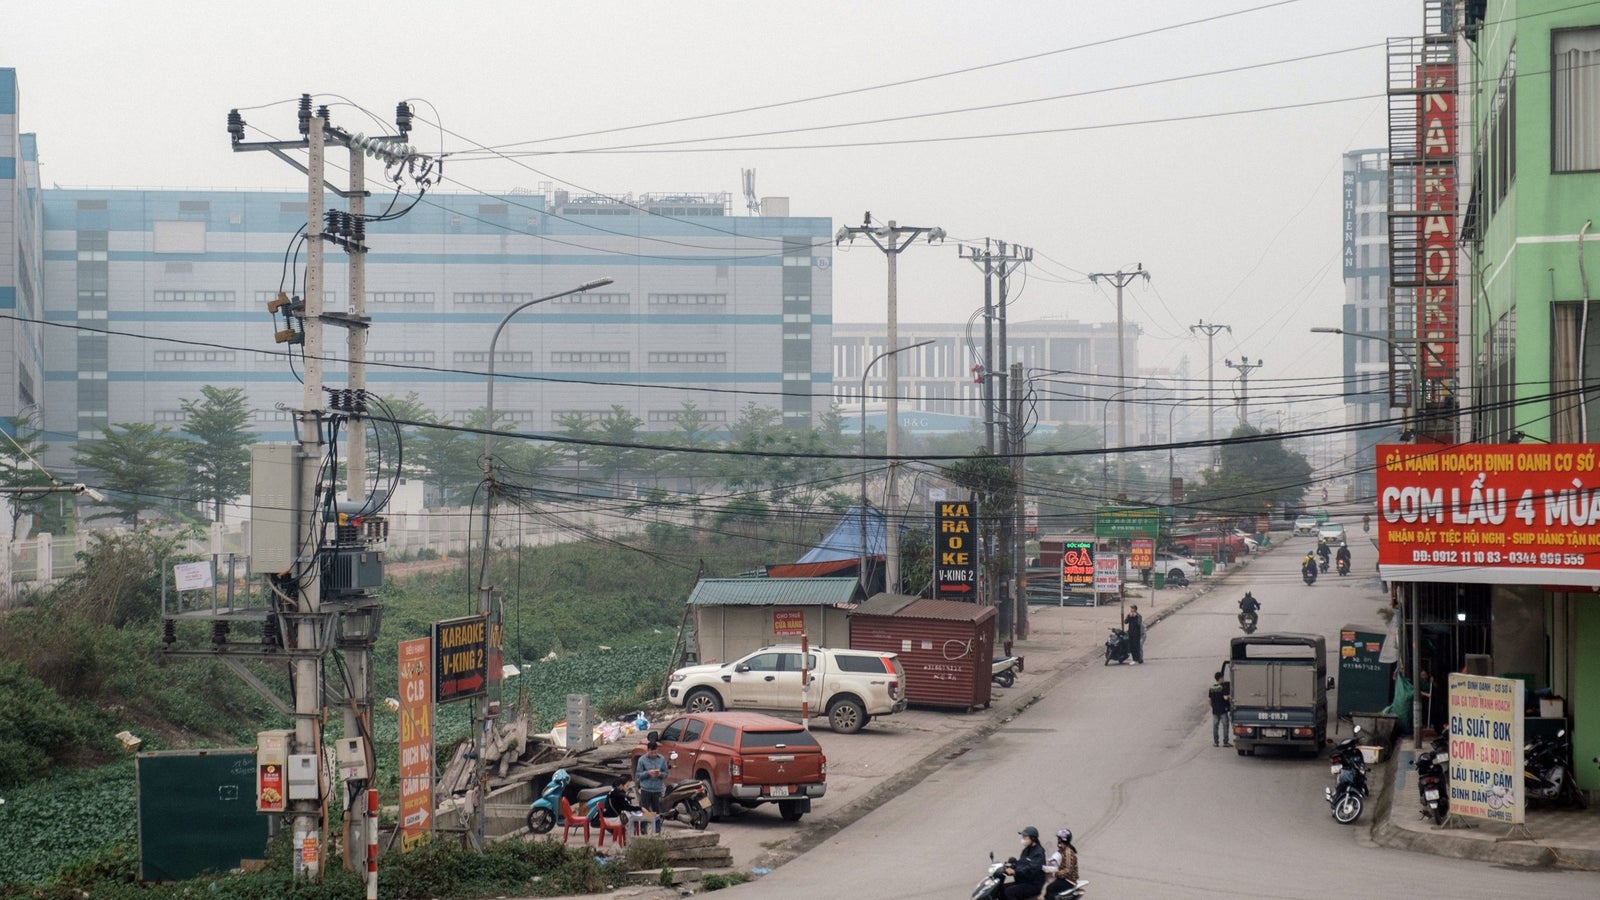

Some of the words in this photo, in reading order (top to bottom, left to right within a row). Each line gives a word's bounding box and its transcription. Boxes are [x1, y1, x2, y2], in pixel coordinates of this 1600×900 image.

[1424, 76, 1450, 368] KARAOKE
[1386, 449, 1403, 471] GÀ
[1405, 454, 1439, 476] MẠNH
[1442, 454, 1482, 476] HOẠCH
[1485, 454, 1514, 475] ĐỊNH
[1517, 454, 1551, 471] OANH
[1555, 454, 1573, 471] CƠ
[1576, 448, 1595, 472] SỞ
[1383, 486, 1443, 524] CƠM
[1452, 473, 1506, 526] LẨU
[1515, 489, 1536, 526] 4
[942, 504, 969, 517] KA
[942, 521, 969, 533] RA
[949, 537, 962, 549] O
[1388, 528, 1415, 545] NHẬN
[1417, 528, 1437, 546] ĐẶT
[1440, 529, 1461, 546] TIỆC
[1463, 529, 1479, 547] HỘI
[1481, 532, 1505, 548] NGHỊ
[1513, 533, 1535, 544] SHIP
[1537, 529, 1564, 545] HÀNG
[1566, 530, 1586, 548] TẬN
[942, 552, 969, 565] KE
[1064, 547, 1093, 566] GÀ
[1432, 551, 1457, 563] 0912
[1461, 551, 1471, 563] 11
[1473, 551, 1485, 563] 10
[1487, 551, 1501, 563] 83
[1509, 552, 1537, 564] 0344
[939, 569, 967, 581] V-KING
[969, 570, 974, 581] 2
[442, 622, 484, 649] KARAOKE
[443, 650, 475, 675] V-KING
[477, 648, 484, 668] 2
[407, 679, 424, 701] CLB
[402, 704, 430, 743] BI-A
[1451, 713, 1463, 735] GÀ
[1466, 712, 1490, 739] SUẤT
[1493, 720, 1511, 742] 80K
[1451, 740, 1475, 760] CƠM
[1451, 762, 1467, 781] LẨU
[1469, 767, 1490, 788] THẬP
[1451, 785, 1470, 801] BÌNH
